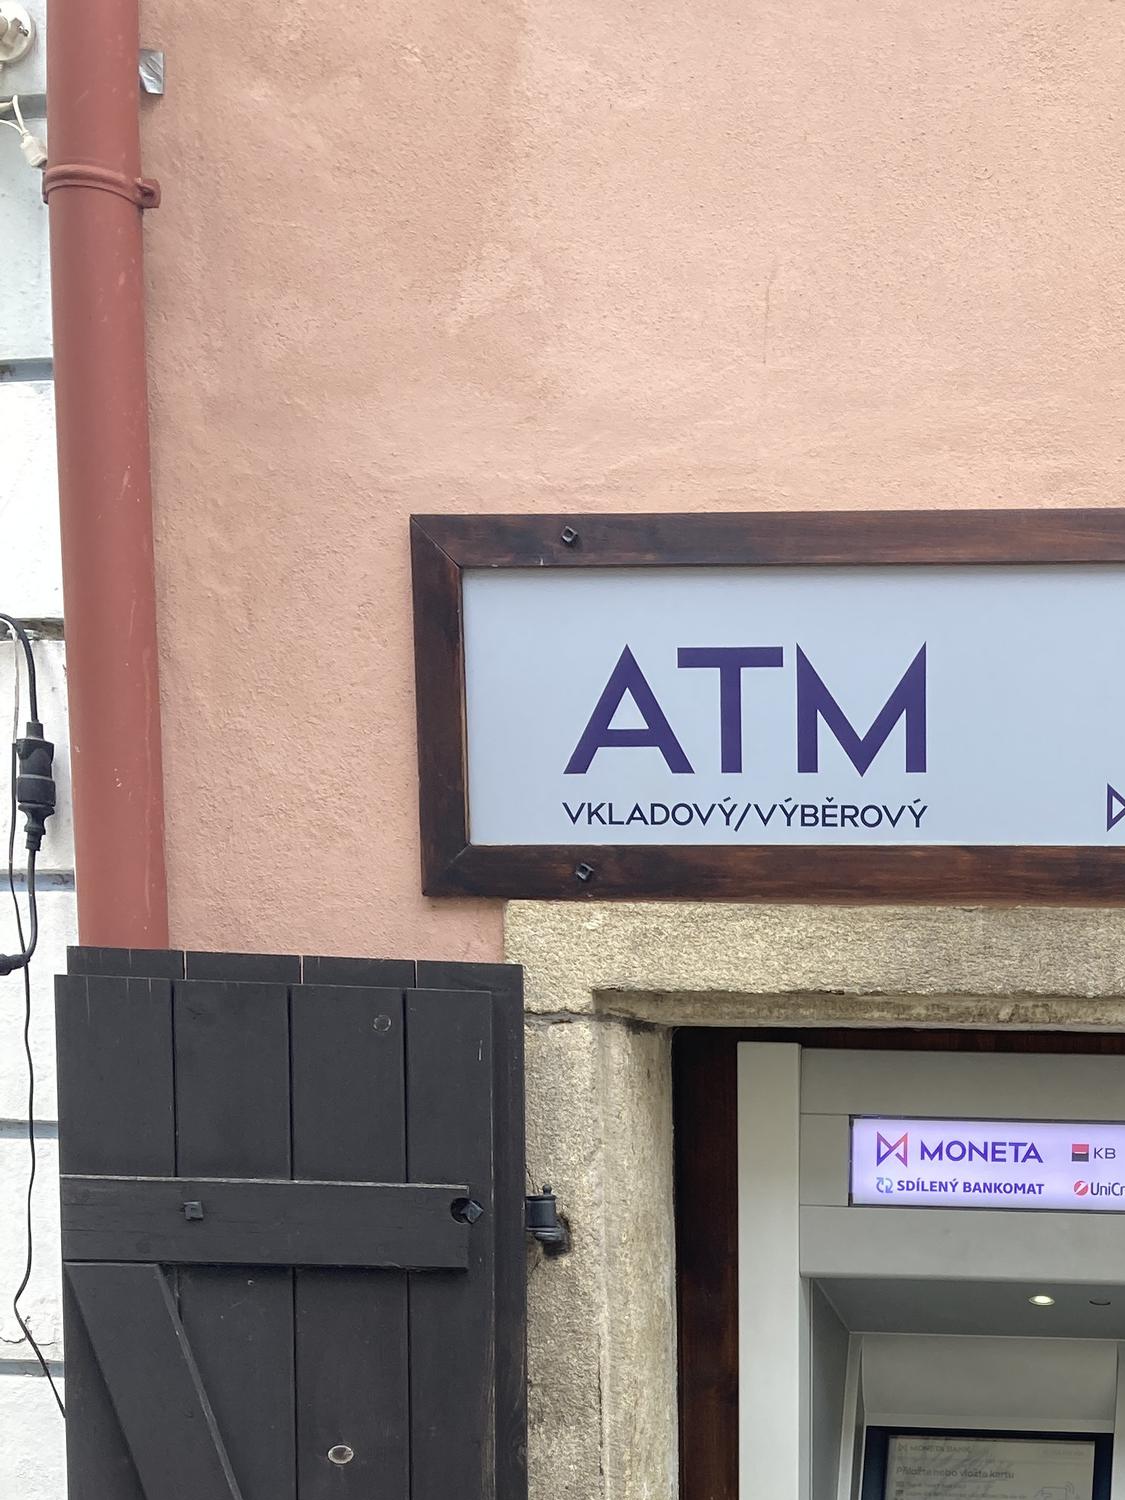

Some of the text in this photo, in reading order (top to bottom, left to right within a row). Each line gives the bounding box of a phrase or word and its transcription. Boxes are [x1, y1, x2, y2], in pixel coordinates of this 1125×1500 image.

[563, 641, 927, 777] ATM
[562, 796, 928, 832] VKLADOVÝ/VÝBĚROVÝ
[920, 1140, 1044, 1163] MONETA
[1093, 1147, 1116, 1160] KB
[897, 1177, 1045, 1195] SDÍLENÝ BANKOMAT
